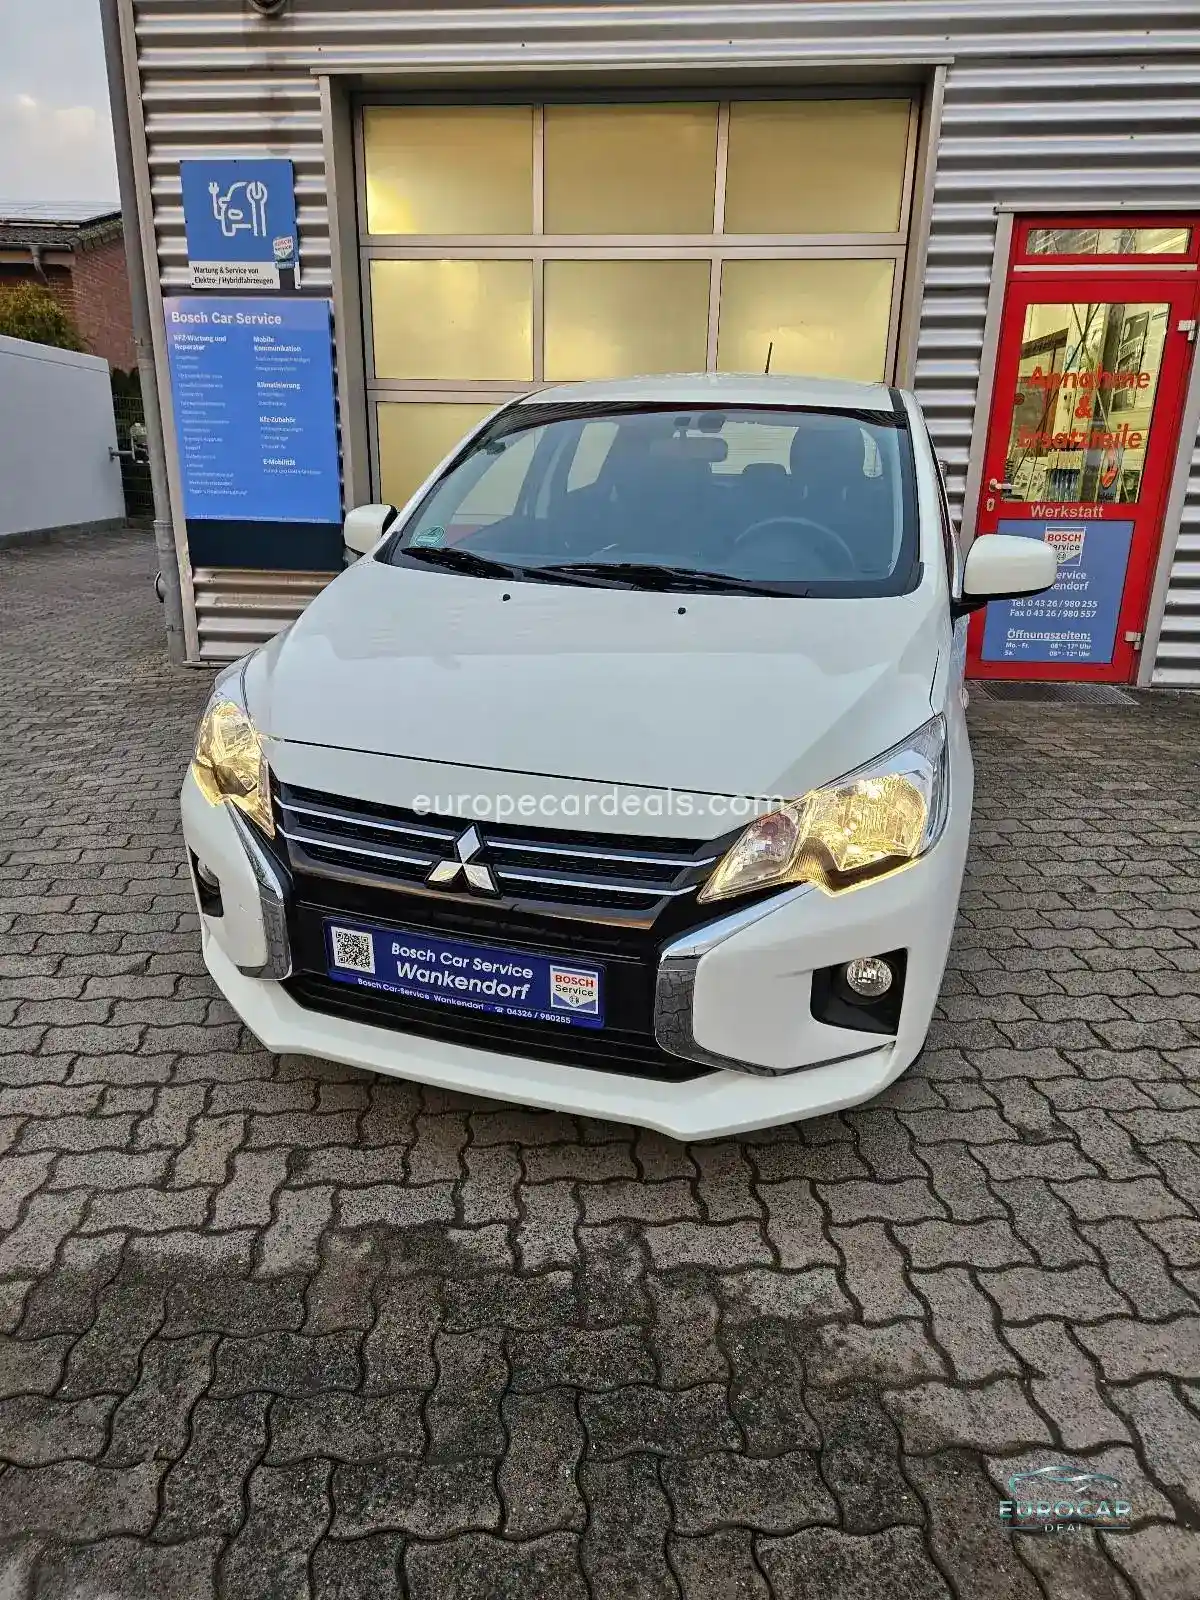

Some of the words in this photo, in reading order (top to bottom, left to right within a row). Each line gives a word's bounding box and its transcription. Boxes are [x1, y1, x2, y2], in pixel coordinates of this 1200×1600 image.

[193, 266, 219, 276] Wartung
[222, 276, 274, 285] Hybridfahrzeugen
[171, 311, 208, 324] Bosch
[211, 312, 233, 324] Car
[236, 312, 282, 325] Service
[1029, 362, 1151, 390] Annahme
[256, 381, 301, 390] Klimatisierung
[1074, 394, 1093, 419] &
[1017, 423, 1143, 449] Ersatzteile
[263, 458, 296, 466] E-Mobilität
[1030, 504, 1104, 518] Werkstatt
[1047, 533, 1082, 542] BOSCH
[1056, 571, 1087, 580] ervice
[1011, 599, 1026, 607] Tel.
[1046, 600, 1058, 608] 26
[1064, 600, 1080, 608] 980
[1081, 600, 1098, 608] 255
[1009, 609, 1025, 617] Fax
[1062, 610, 1079, 618] 980
[1080, 610, 1097, 618] 557
[1006, 628, 1091, 640] Öffnungszeiten:
[391, 942, 437, 963] Bosch
[440, 952, 469, 969] Car
[472, 957, 534, 979] Service
[396, 960, 531, 1000] Wankendorf
[555, 974, 594, 988] BOSCH
[555, 984, 594, 997] Service
[357, 977, 383, 990] Bosch
[383, 983, 430, 1000] Car-Service
[433, 993, 485, 1011] Wankendorf
[506, 1008, 533, 1018] 04326
[540, 1012, 571, 1024] 980255
